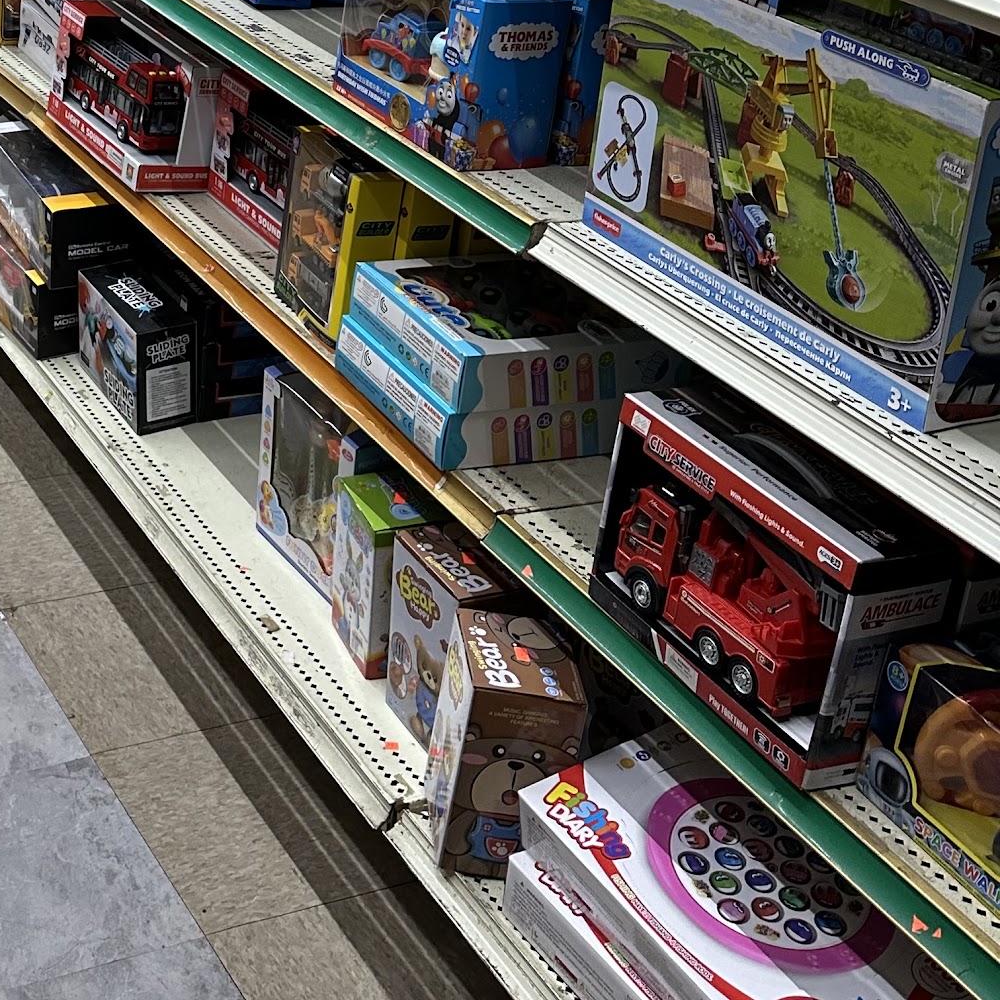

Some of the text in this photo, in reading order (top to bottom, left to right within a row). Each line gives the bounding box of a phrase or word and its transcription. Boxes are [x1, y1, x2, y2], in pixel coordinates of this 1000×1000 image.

[499, 30, 553, 42] THOMAS
[509, 42, 548, 51] FRIENDS
[831, 36, 893, 69] PUSH ALONG
[88, 56, 116, 80] CITY TOUR BUS
[200, 79, 220, 90] CITY
[65, 110, 79, 128] LIGHT
[86, 128, 105, 150] SOUND
[253, 130, 287, 160] CITY TOUR BUS
[144, 172, 164, 180] LIGHT
[943, 160, 966, 176] METAL
[231, 192, 250, 212] LIGHT
[257, 213, 281, 239] SOUND
[363, 221, 393, 229] CITY
[67, 243, 130, 257] MODEL CAR
[107, 275, 164, 310] SLIDING PLATE
[648, 252, 668, 271] Carlys
[668, 263, 711, 297] Überquerung
[723, 297, 740, 313] cruce
[740, 309, 750, 319] de
[750, 314, 769, 333] Carly
[660, 247, 841, 364] Carly's Crossing Le croisement de Carly
[145, 333, 190, 356] SLIDING
[411, 323, 434, 348] PRECAUCIONES
[151, 344, 187, 365] PLATE
[440, 343, 461, 367] WARNING
[103, 367, 135, 404] SLIDING
[824, 361, 852, 383] Карли
[106, 387, 134, 421] PLATE
[394, 377, 417, 401] PRECAUCIONES
[887, 386, 912, 413] 3+
[423, 399, 444, 424] WARNING
[648, 434, 675, 463] CITY
[672, 455, 717, 492] SERVICE
[718, 444, 799, 501] Superior Performance
[730, 489, 741, 503] With
[741, 496, 764, 520] Flashing
[763, 512, 780, 531] Lights
[431, 551, 493, 593] Bear
[400, 572, 436, 614] Bear
[860, 592, 943, 623] AMBULACE
[475, 636, 522, 688] Bear
[708, 694, 720, 711] Play
[544, 782, 631, 859] Fishing
[547, 801, 604, 849] DIARY
[914, 816, 961, 868] SPACE
